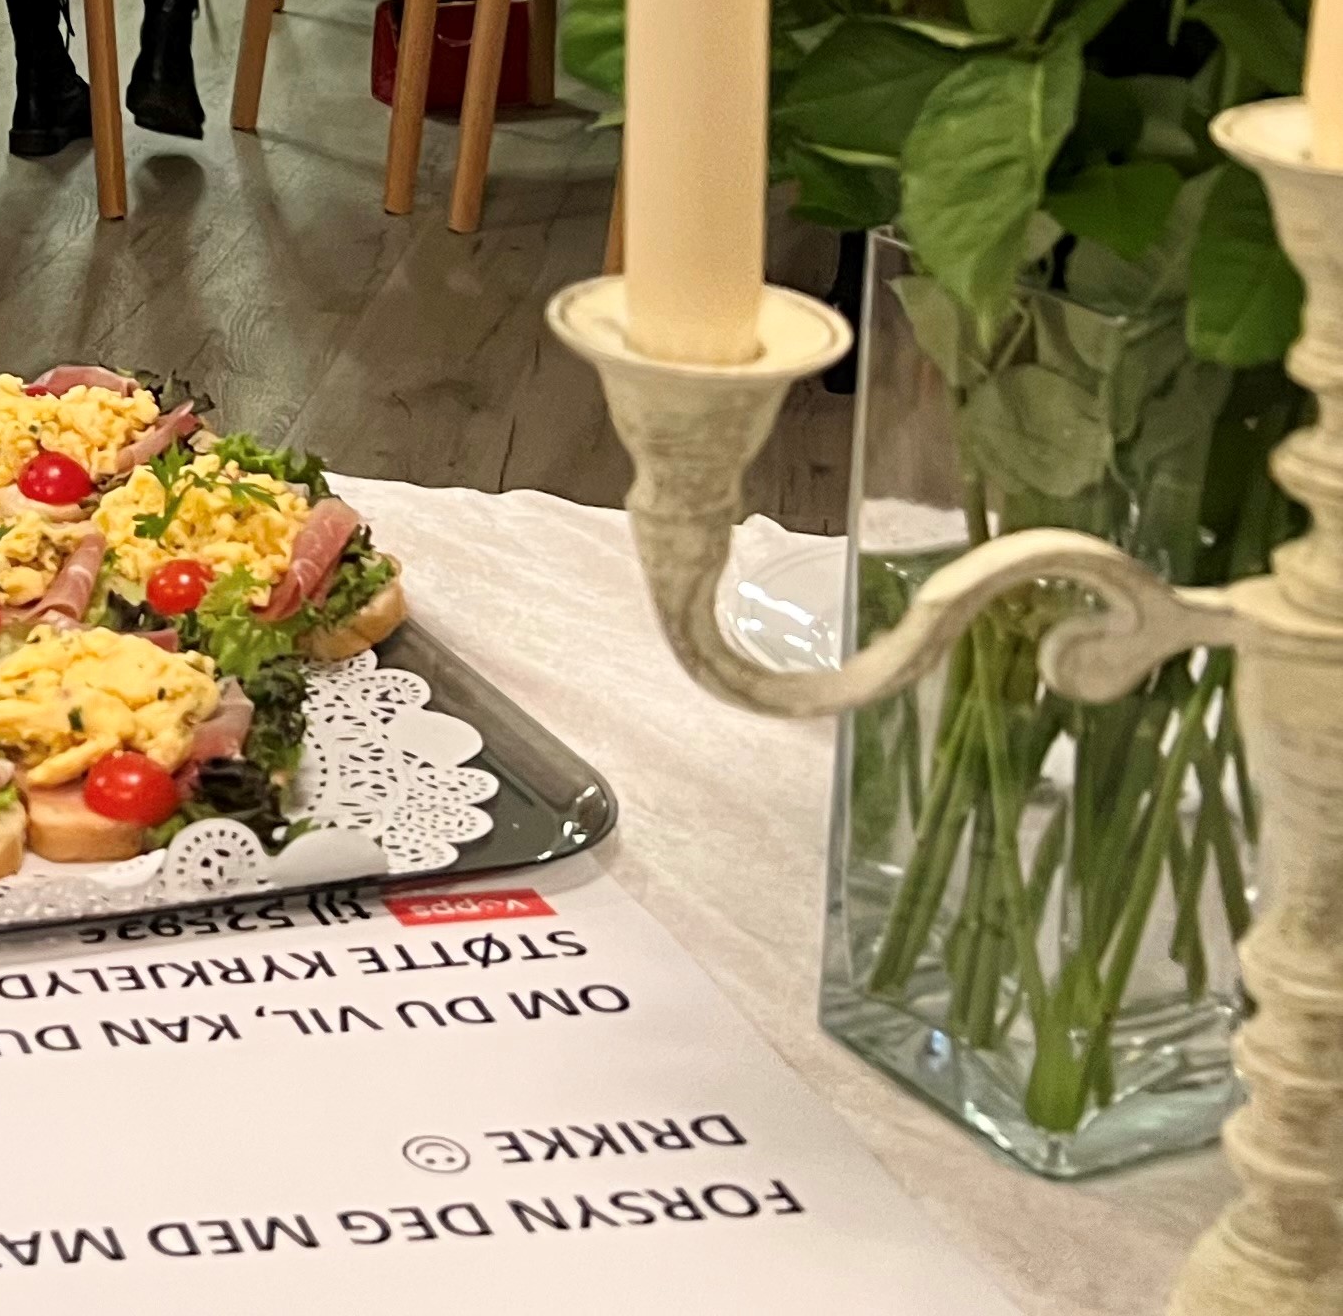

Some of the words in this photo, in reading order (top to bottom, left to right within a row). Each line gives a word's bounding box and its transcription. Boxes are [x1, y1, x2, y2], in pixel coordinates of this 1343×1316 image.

[346, 930, 589, 975] STØTTE
[254, 1004, 385, 1036] VIL,
[396, 995, 497, 1029] DU
[507, 984, 631, 1020] OM
[98, 1013, 243, 1048] KAN
[483, 1114, 748, 1164] DRIKKE
[336, 1201, 495, 1246] DEG
[505, 1178, 806, 1233] FORSYN
[147, 1213, 321, 1257] MED
